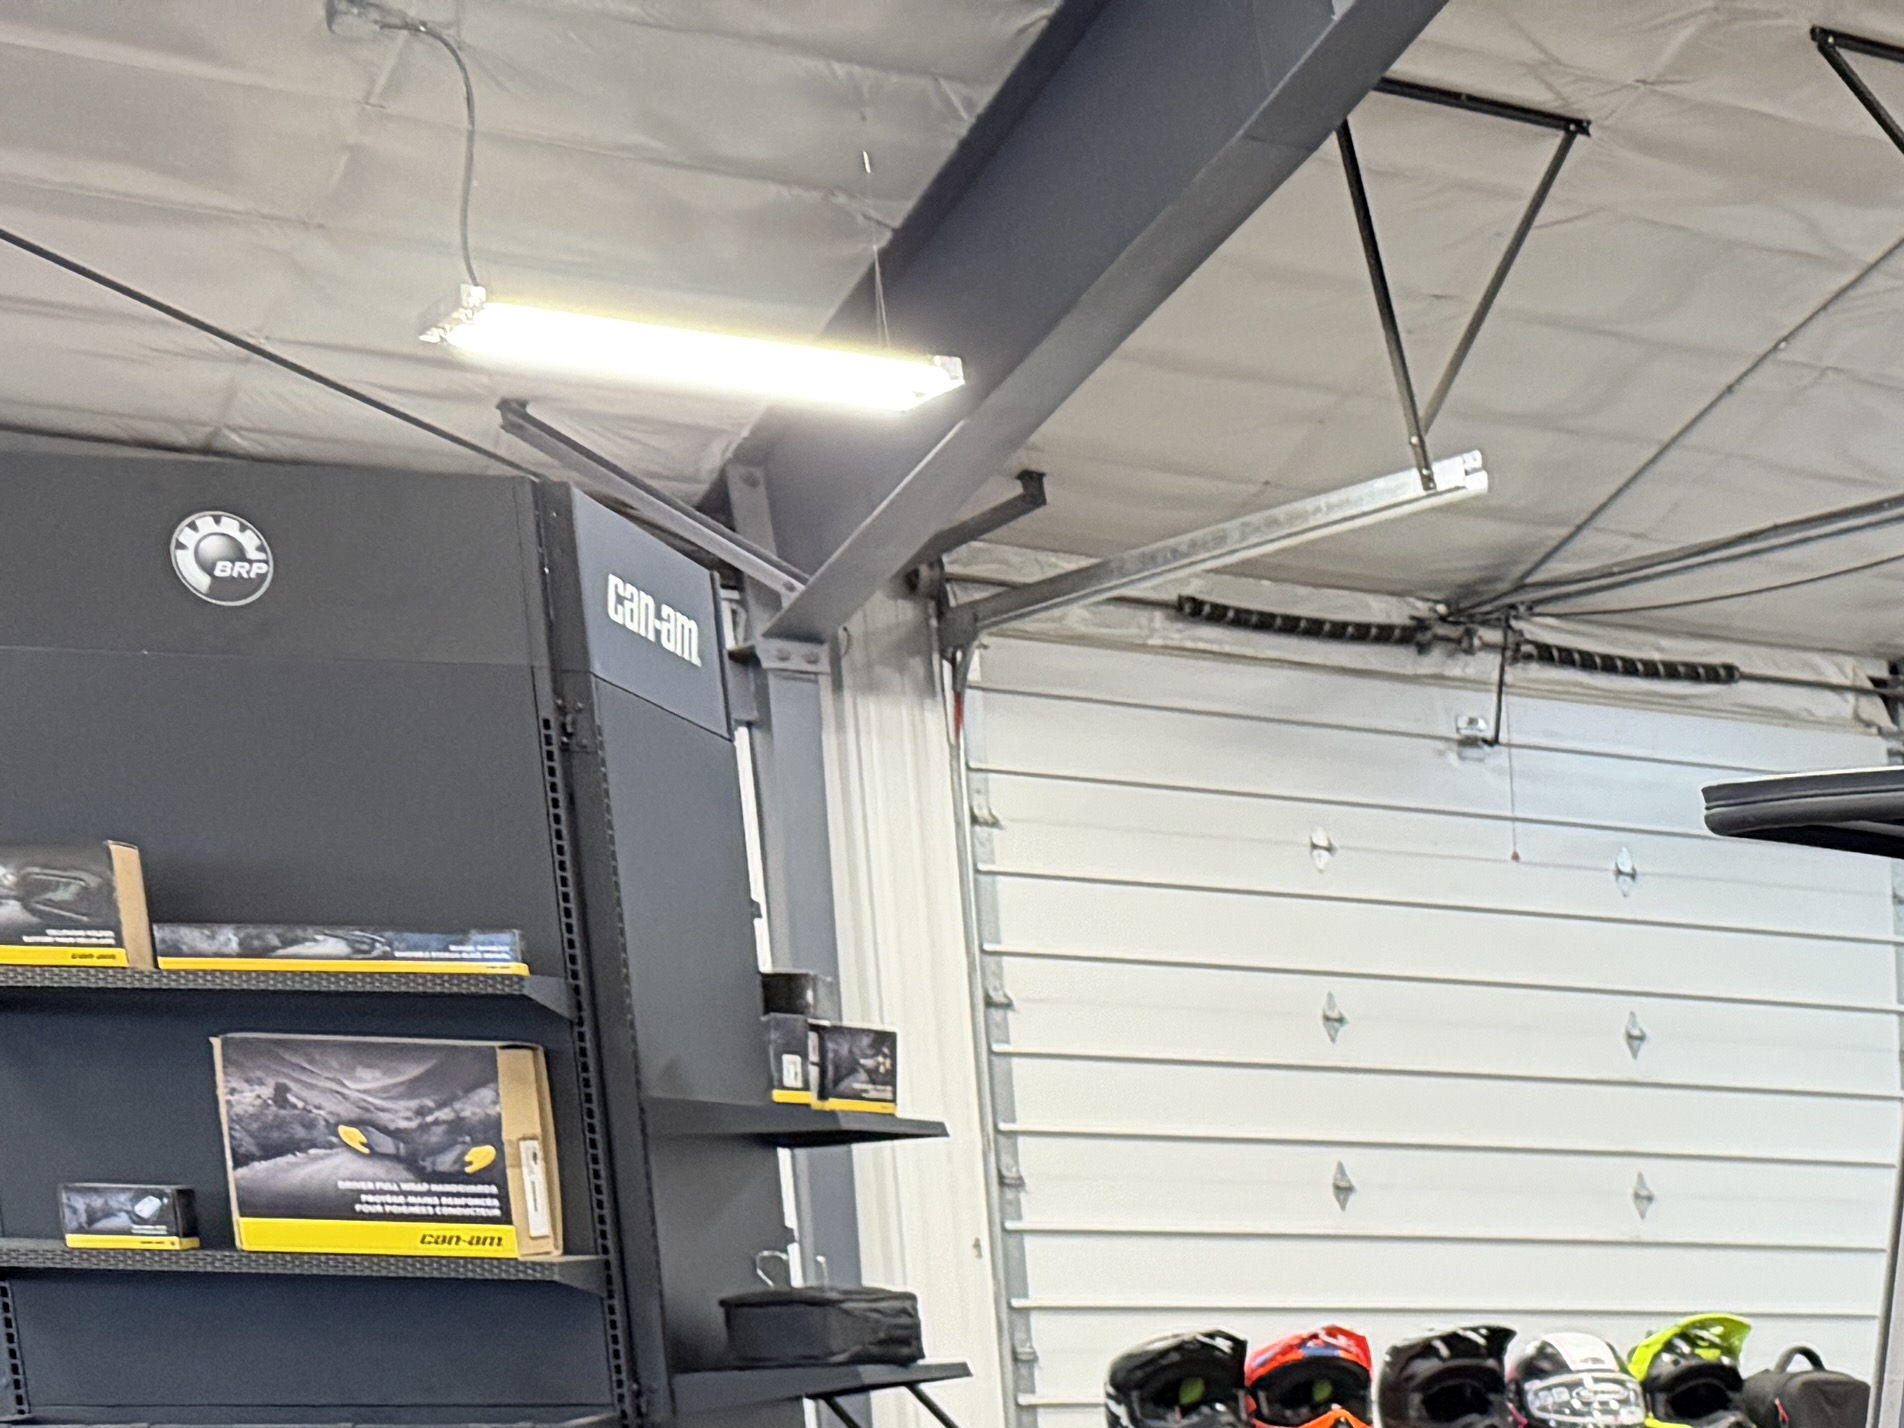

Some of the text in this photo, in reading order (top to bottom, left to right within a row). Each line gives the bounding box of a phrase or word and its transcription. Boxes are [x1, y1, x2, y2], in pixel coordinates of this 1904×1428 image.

[214, 560, 268, 579] BRP
[607, 573, 702, 667] can-am
[420, 1233, 503, 1247] can-am
